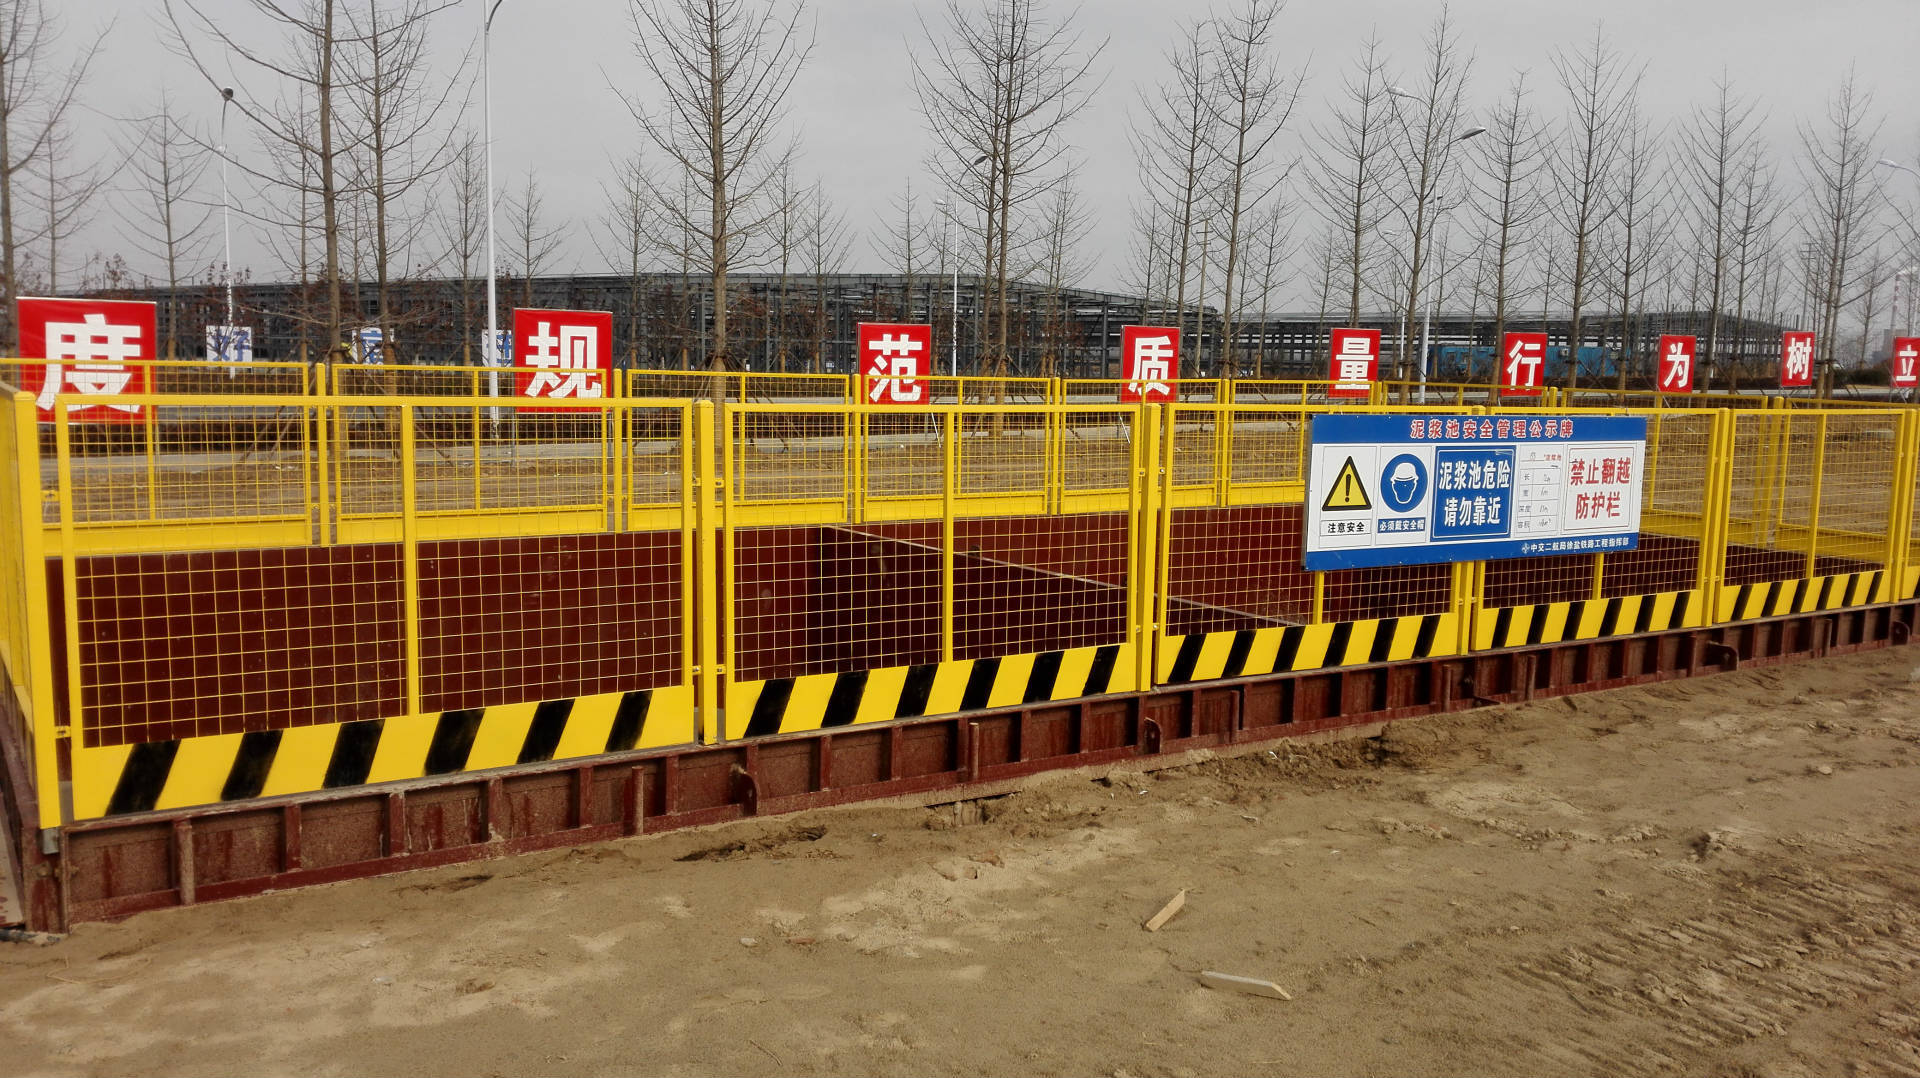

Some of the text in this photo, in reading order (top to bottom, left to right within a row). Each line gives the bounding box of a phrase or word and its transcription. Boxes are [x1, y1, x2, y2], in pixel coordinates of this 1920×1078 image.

[36, 313, 141, 413] 度
[525, 321, 602, 398] 规
[868, 334, 922, 402] 范
[1128, 336, 1174, 396] 质
[1336, 337, 1375, 390] 量
[1506, 340, 1542, 390] 行
[1664, 342, 1691, 388] 为
[1787, 337, 1812, 379] 树
[1895, 344, 1918, 381] 立
[1410, 419, 1574, 438] 泥浆池安全管理公示牌
[1438, 459, 1511, 490] 泥浆池危险
[1570, 457, 1631, 486] 禁止翻越
[1444, 496, 1501, 527] 请勿靠近
[1575, 491, 1621, 520] 防护栏
[1327, 522, 1365, 533] 注意安全
